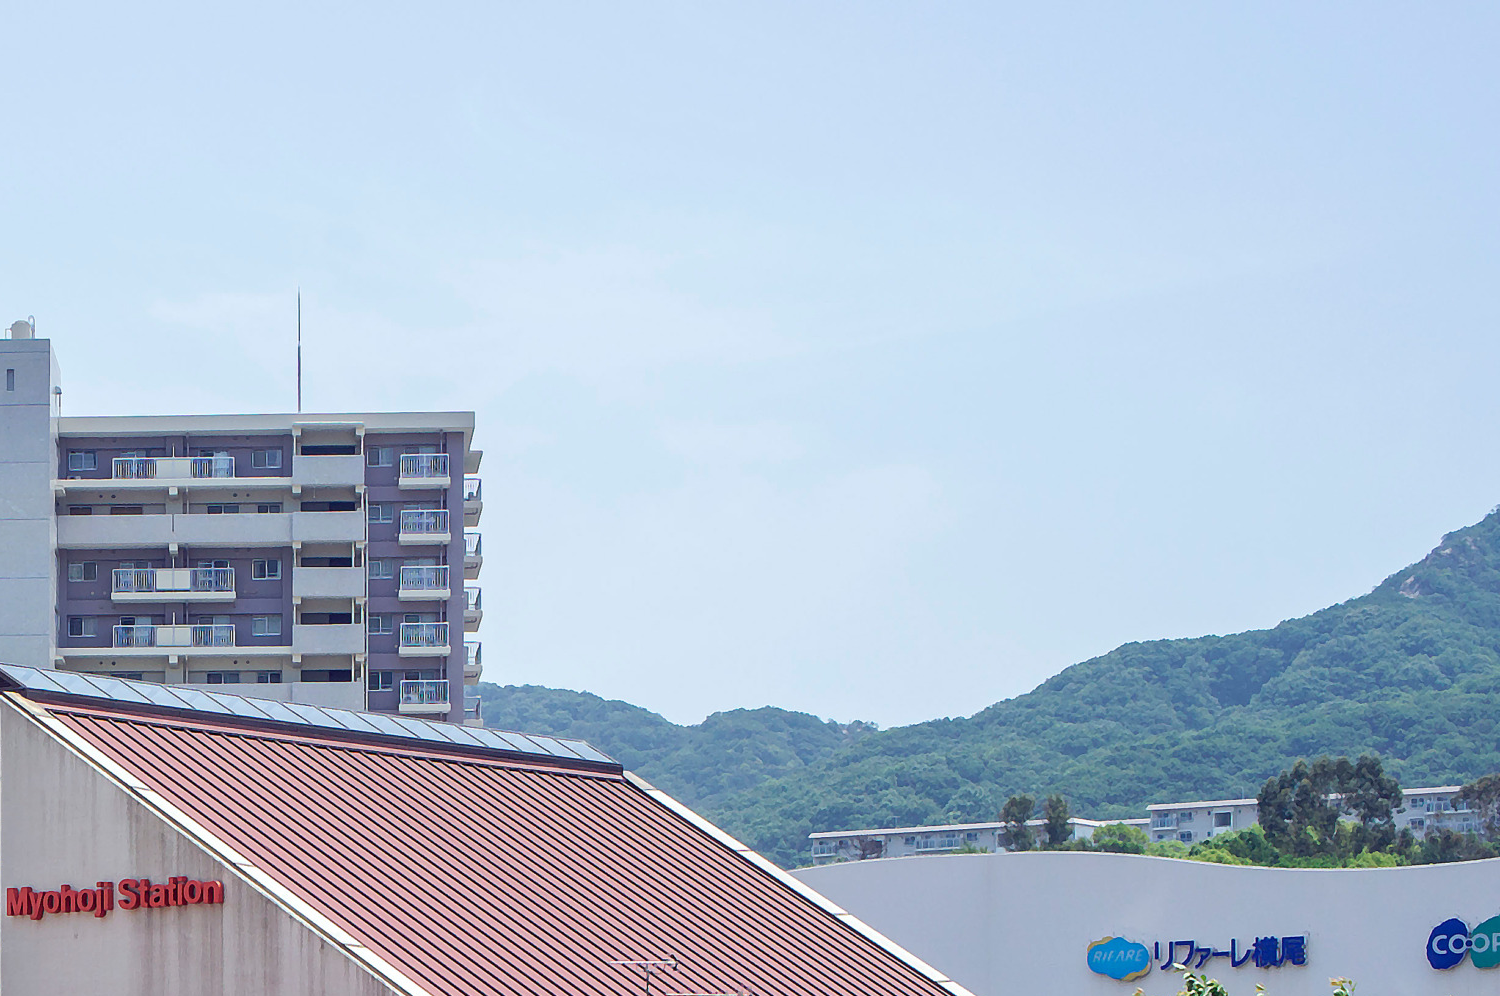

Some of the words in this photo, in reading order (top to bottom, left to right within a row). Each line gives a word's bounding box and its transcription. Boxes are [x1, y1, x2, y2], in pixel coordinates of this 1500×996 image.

[6, 881, 114, 920] Myohoji
[118, 876, 224, 911] Station
[1154, 934, 1307, 971] リファーレ横尾
